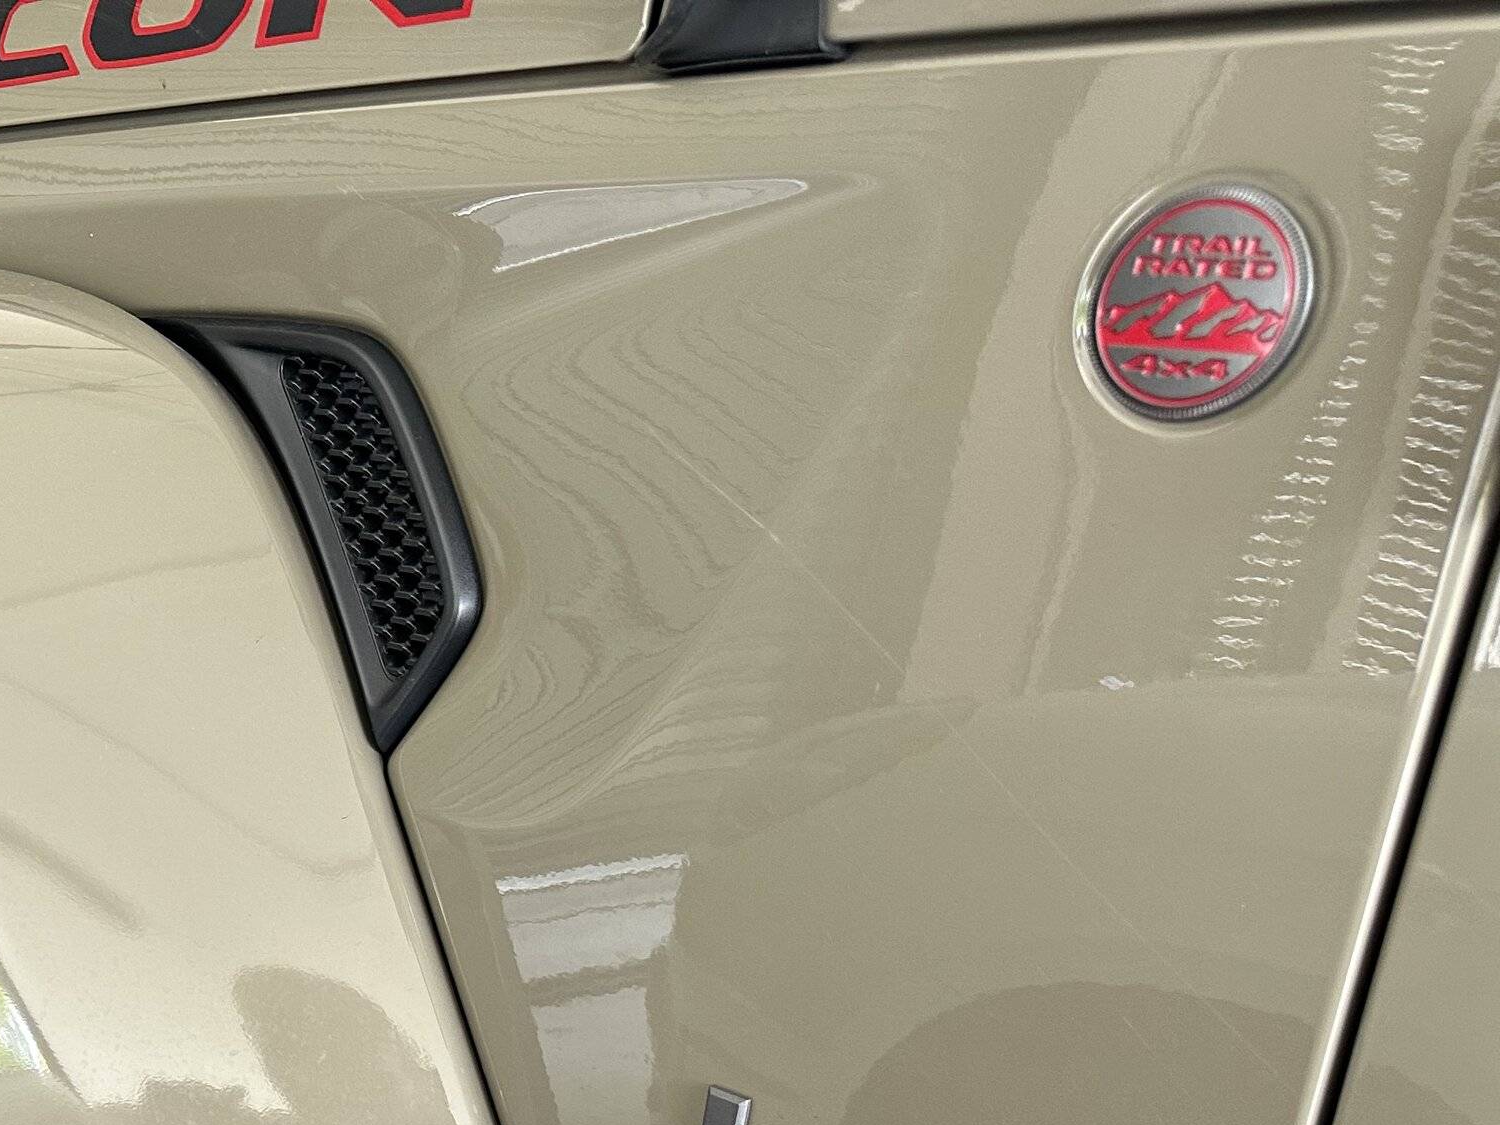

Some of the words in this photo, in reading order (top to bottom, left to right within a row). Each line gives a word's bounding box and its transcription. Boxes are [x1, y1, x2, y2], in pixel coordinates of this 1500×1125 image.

[1151, 234, 1271, 257] TRAIL
[1132, 255, 1278, 280] RATED
[1121, 354, 1230, 381] 4x4
